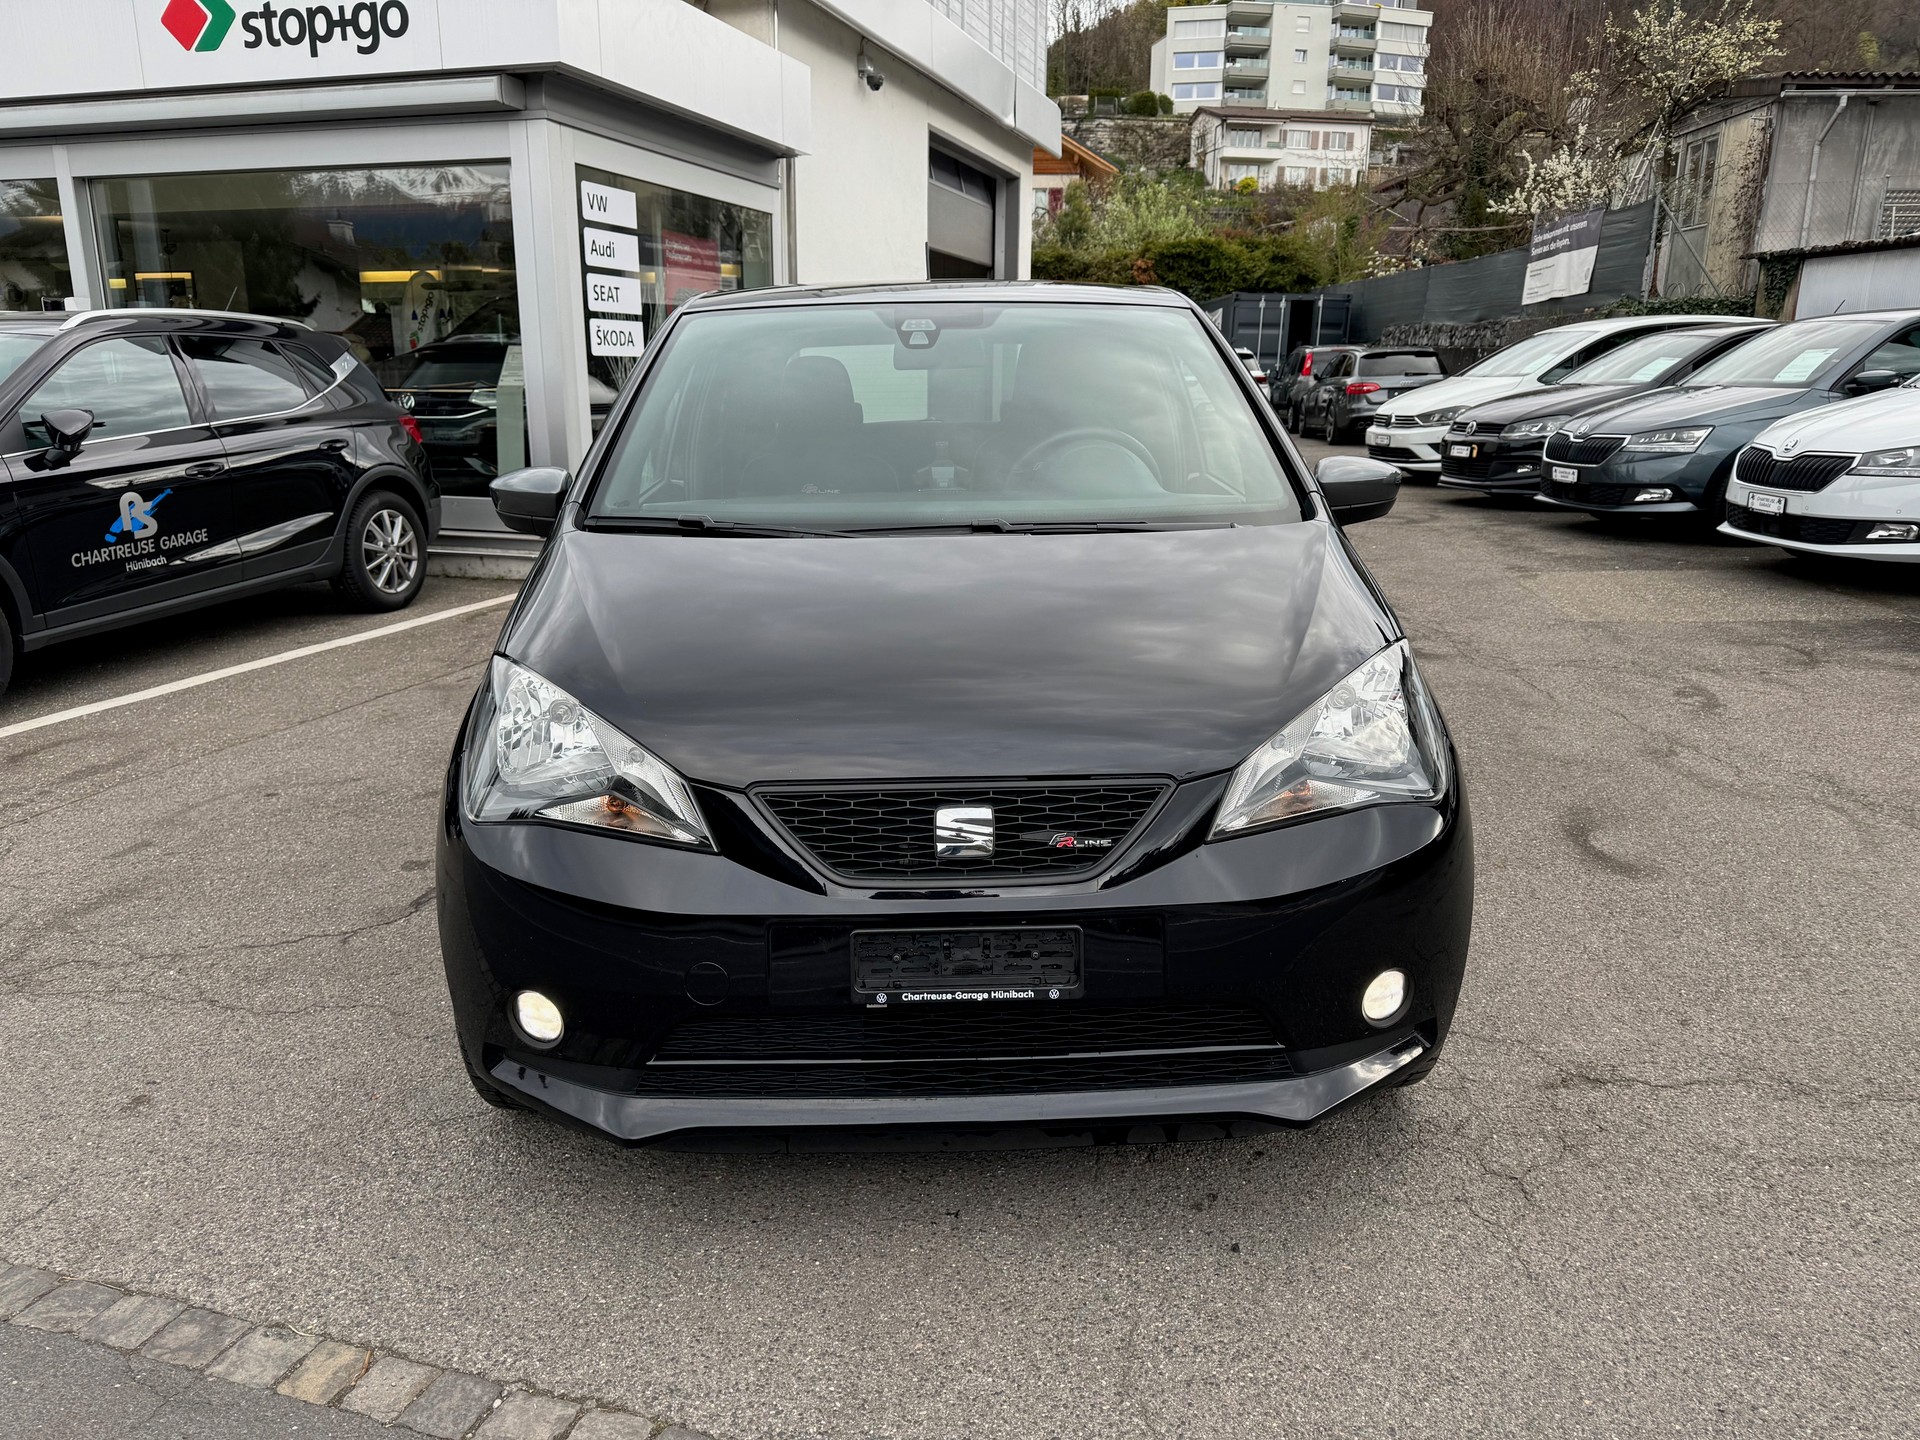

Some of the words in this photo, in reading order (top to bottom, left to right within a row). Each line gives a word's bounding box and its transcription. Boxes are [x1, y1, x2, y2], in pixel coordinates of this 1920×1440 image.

[241, 0, 410, 58] stop+go
[587, 192, 608, 213] VW
[590, 239, 616, 259] Audi
[593, 284, 620, 303] SEAT
[595, 325, 635, 347] ŠKODA
[71, 539, 156, 568] CHARTREUSE
[160, 528, 209, 550] GARAGE
[125, 555, 167, 572] Hünibach
[901, 991, 989, 1001] Chartreuse-Garage
[991, 989, 1035, 999] Hünibach
